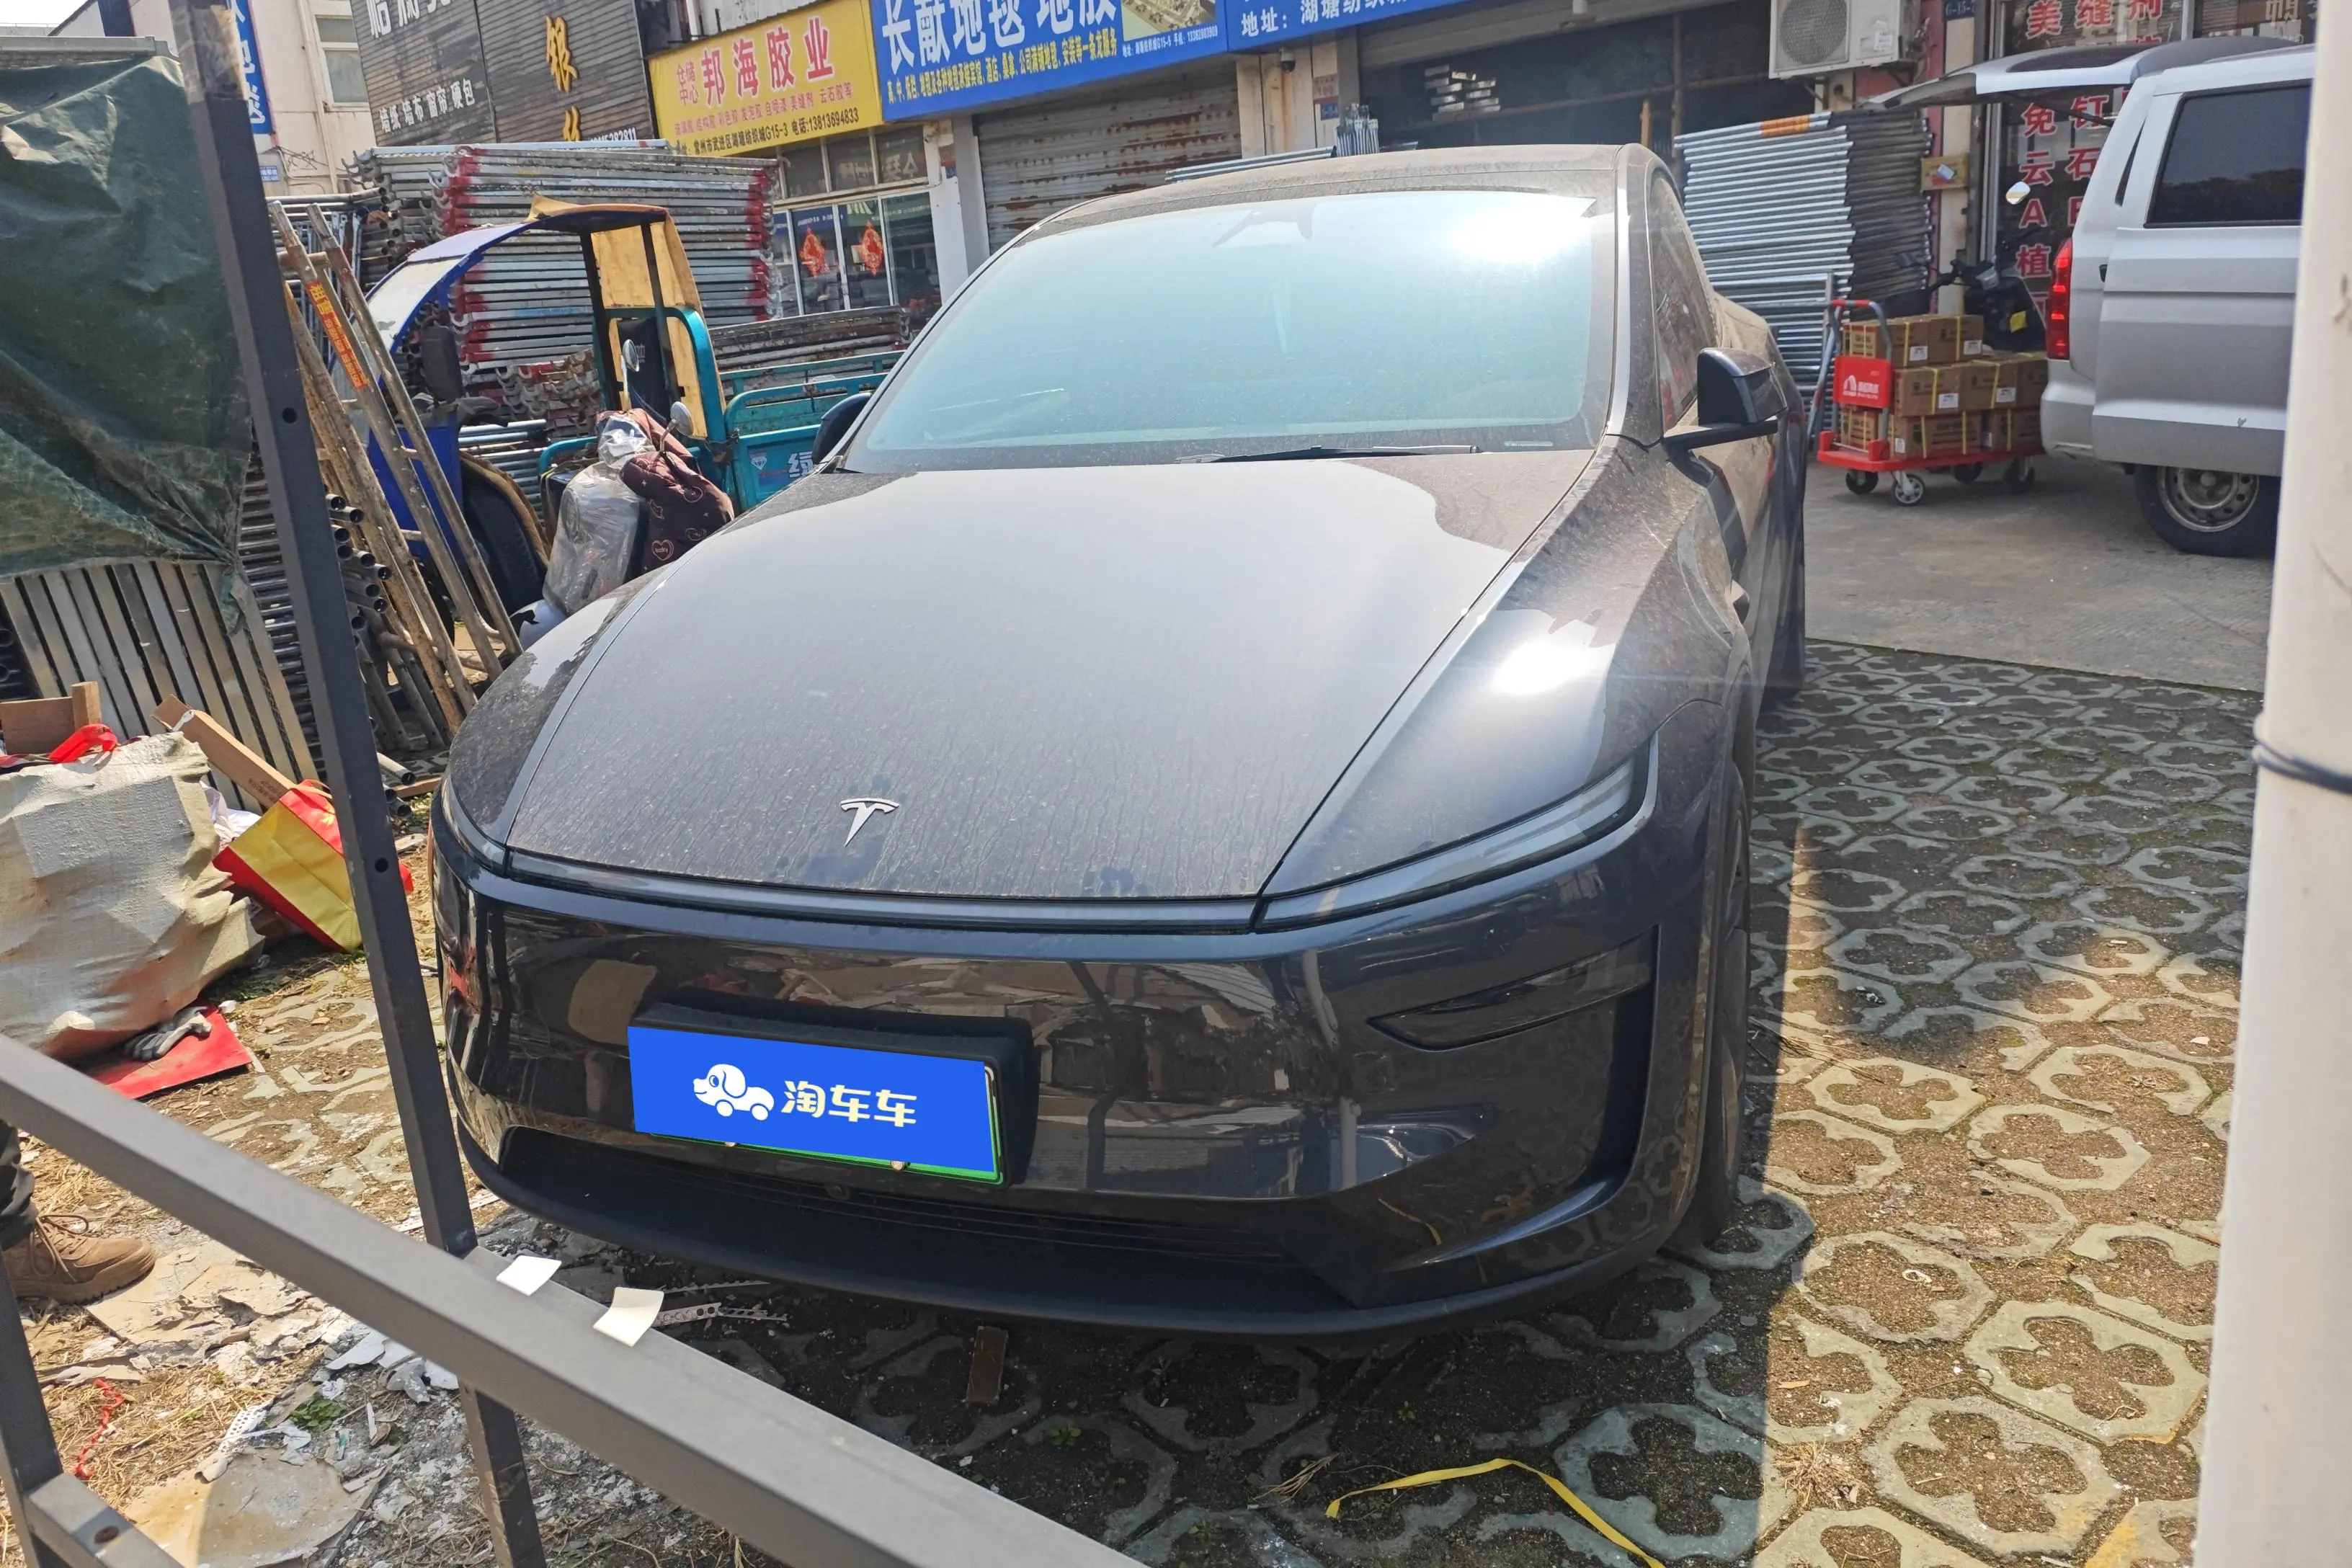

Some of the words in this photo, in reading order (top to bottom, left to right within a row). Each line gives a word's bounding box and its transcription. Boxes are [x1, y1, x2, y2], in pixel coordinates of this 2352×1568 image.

[700, 16, 834, 107] 邦海胶业
[680, 82, 699, 107] 中心
